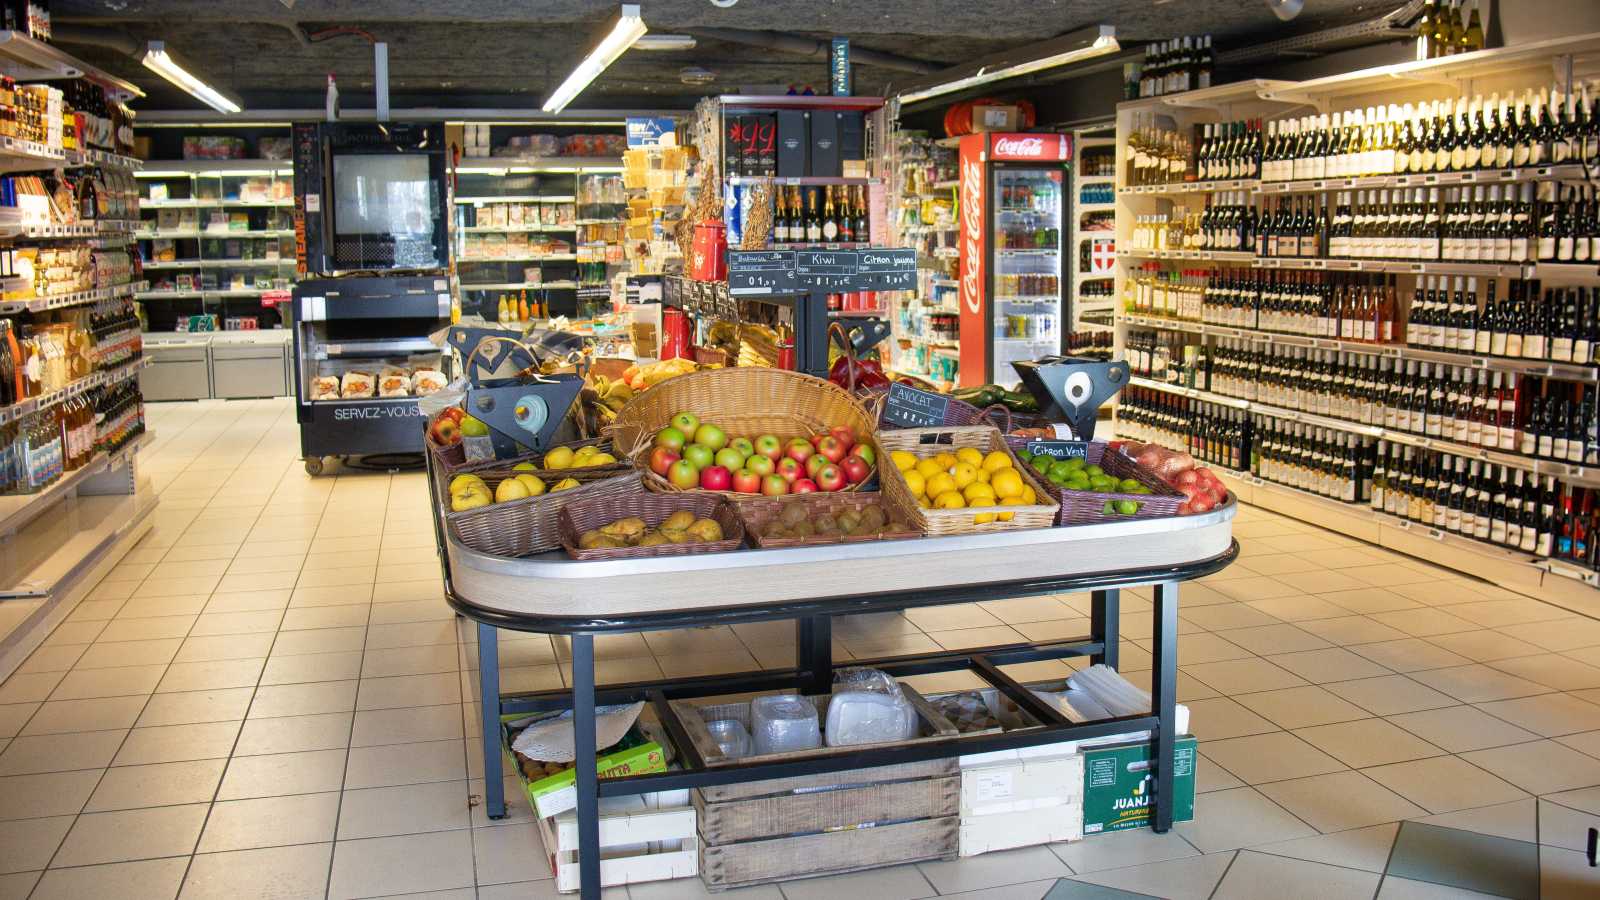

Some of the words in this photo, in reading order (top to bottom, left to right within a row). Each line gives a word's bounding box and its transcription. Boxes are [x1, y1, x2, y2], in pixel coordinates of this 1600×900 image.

[994, 137, 1043, 156] Coca-Cola
[294, 194, 307, 273] STEAMBOX
[963, 155, 981, 314] Coca-Cola
[812, 253, 835, 265] Kiwi
[897, 388, 933, 407] AVOCAT
